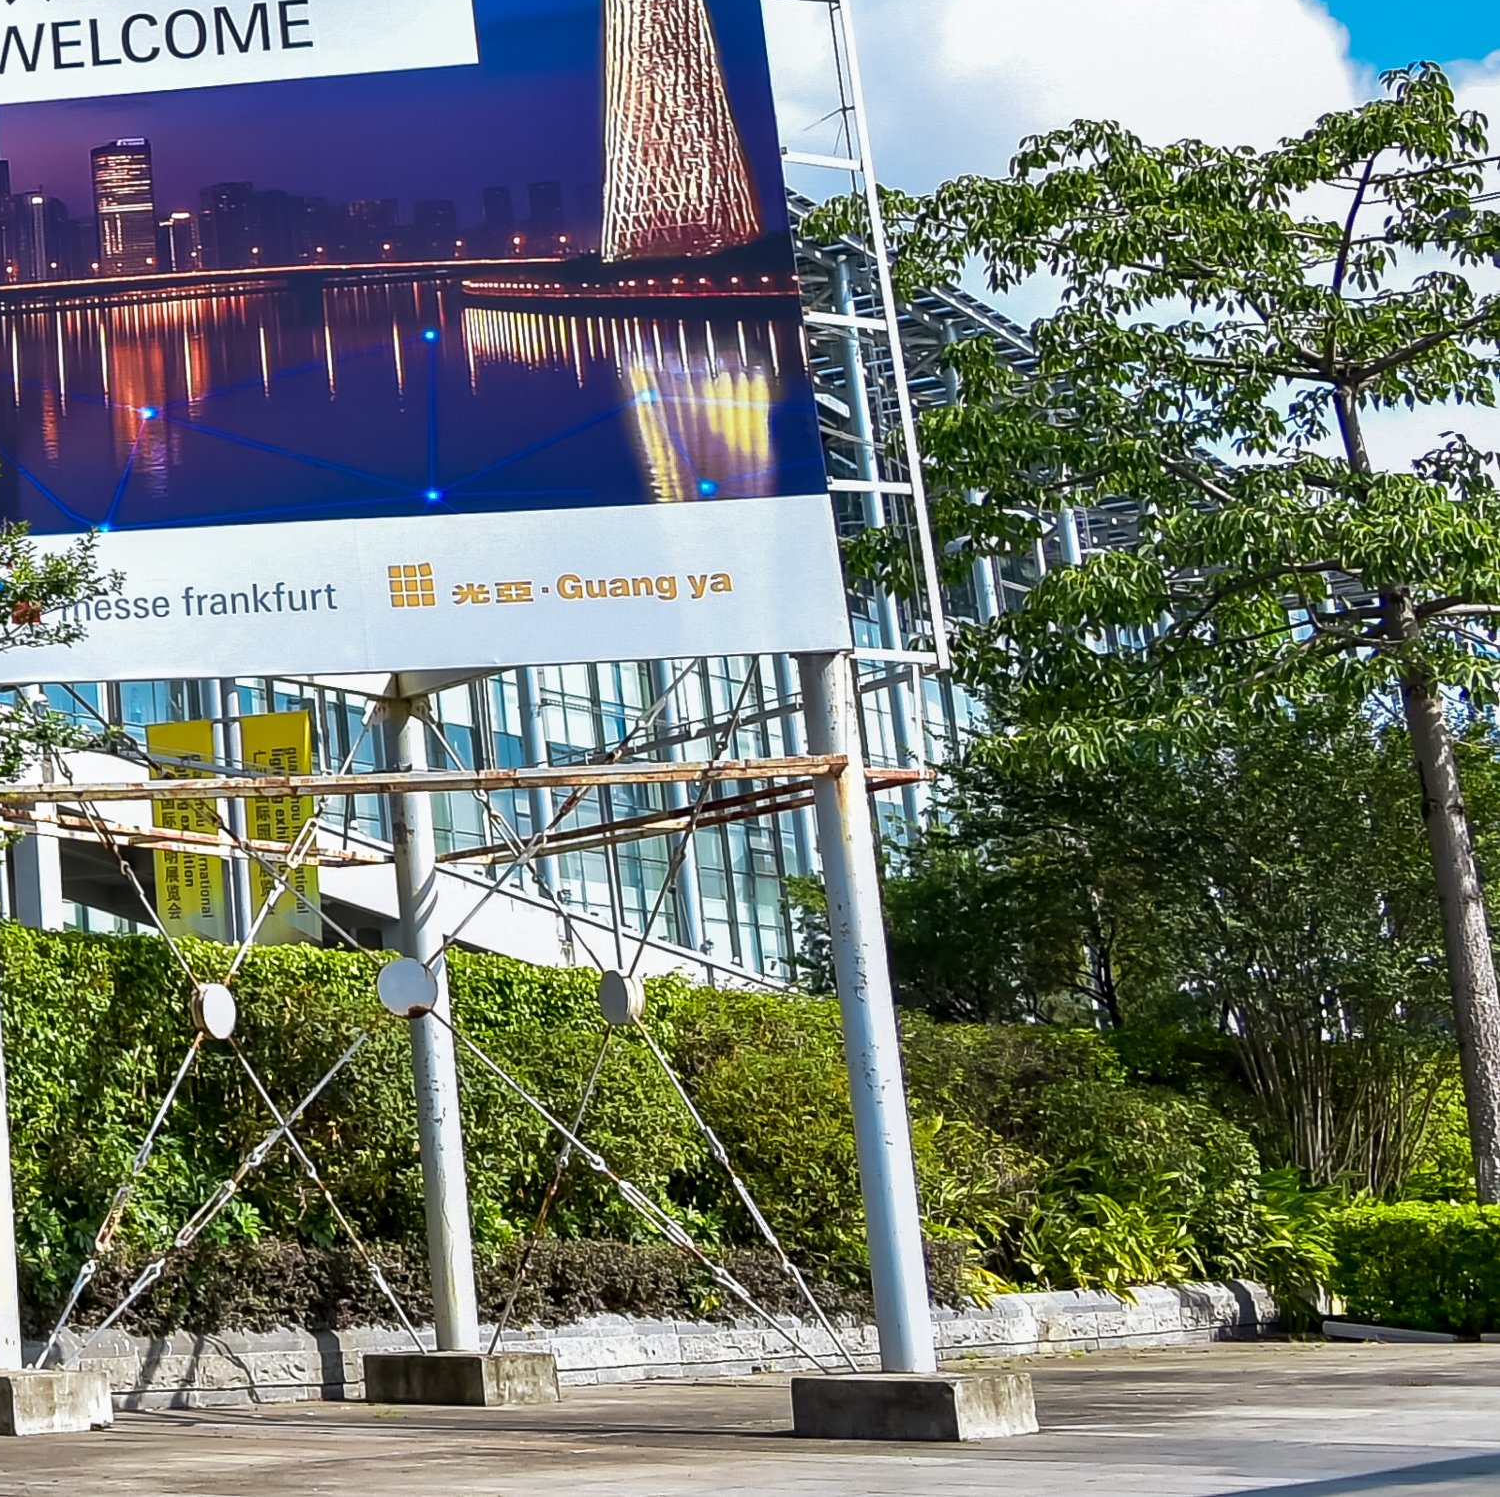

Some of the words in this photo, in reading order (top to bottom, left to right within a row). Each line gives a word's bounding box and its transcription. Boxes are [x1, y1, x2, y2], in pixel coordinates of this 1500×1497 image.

[181, 581, 338, 617] frankfurt
[556, 573, 676, 600] Guang
[688, 572, 733, 599] ya
